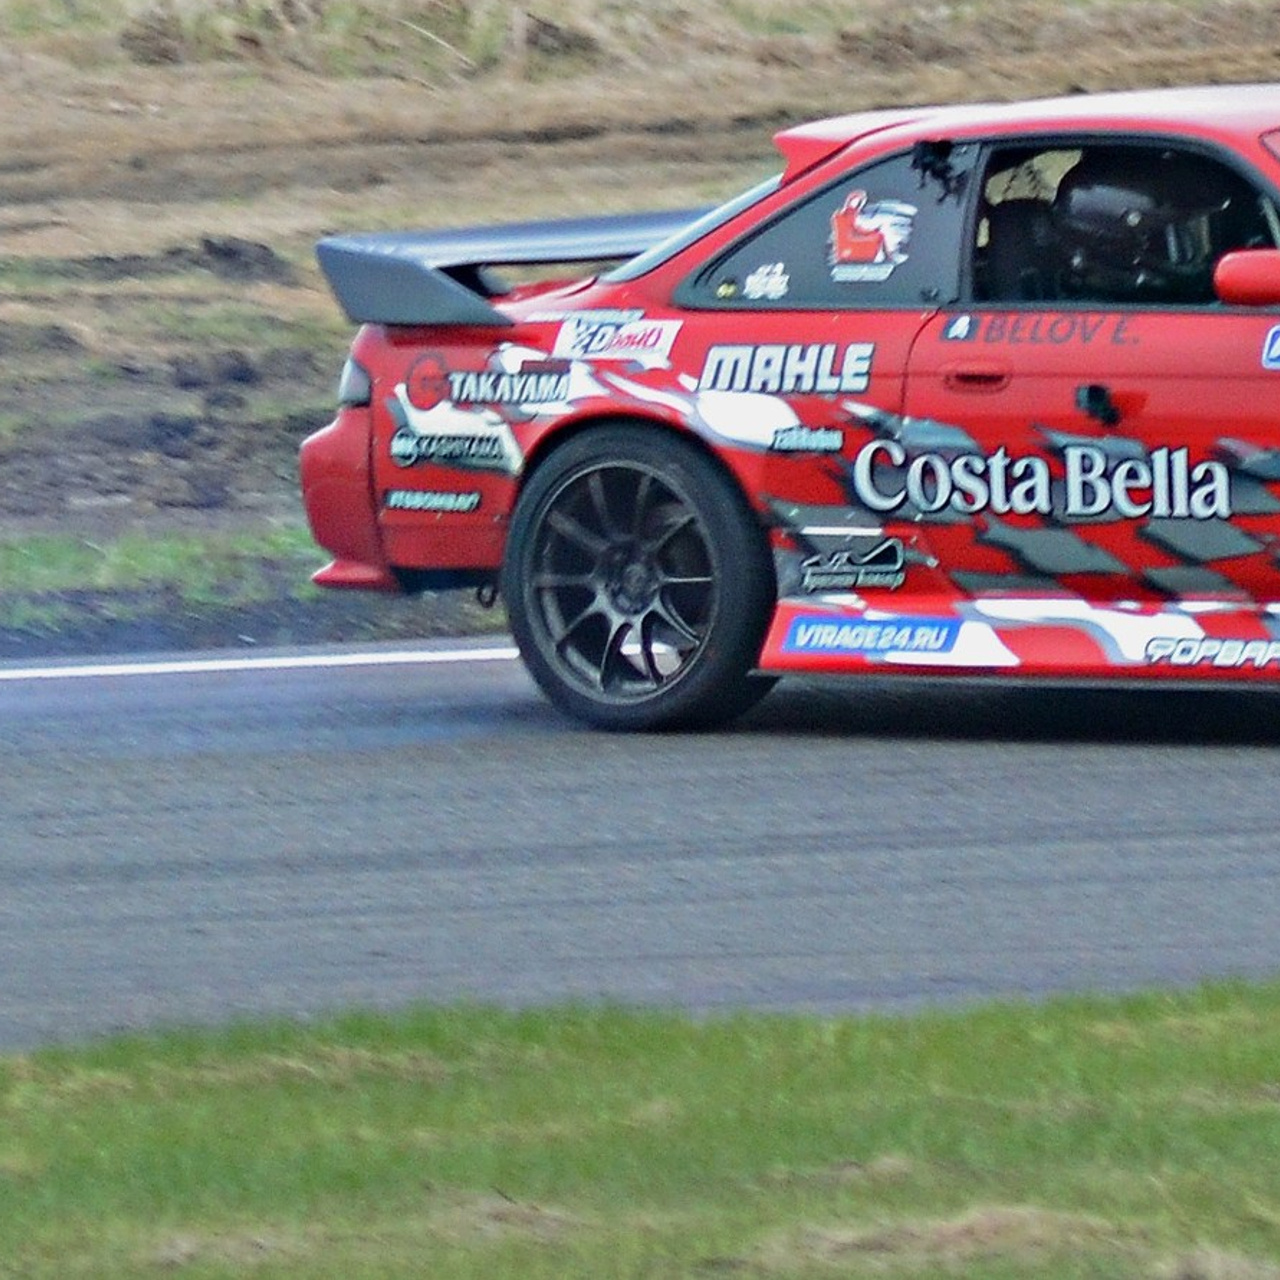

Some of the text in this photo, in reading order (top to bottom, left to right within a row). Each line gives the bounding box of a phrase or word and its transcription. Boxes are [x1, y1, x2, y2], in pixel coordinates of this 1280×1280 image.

[984, 315, 1105, 344] BELOV
[448, 371, 571, 403] TAKAYAMA
[699, 343, 875, 393] MAHLE
[853, 439, 1233, 519] Costa Bella
